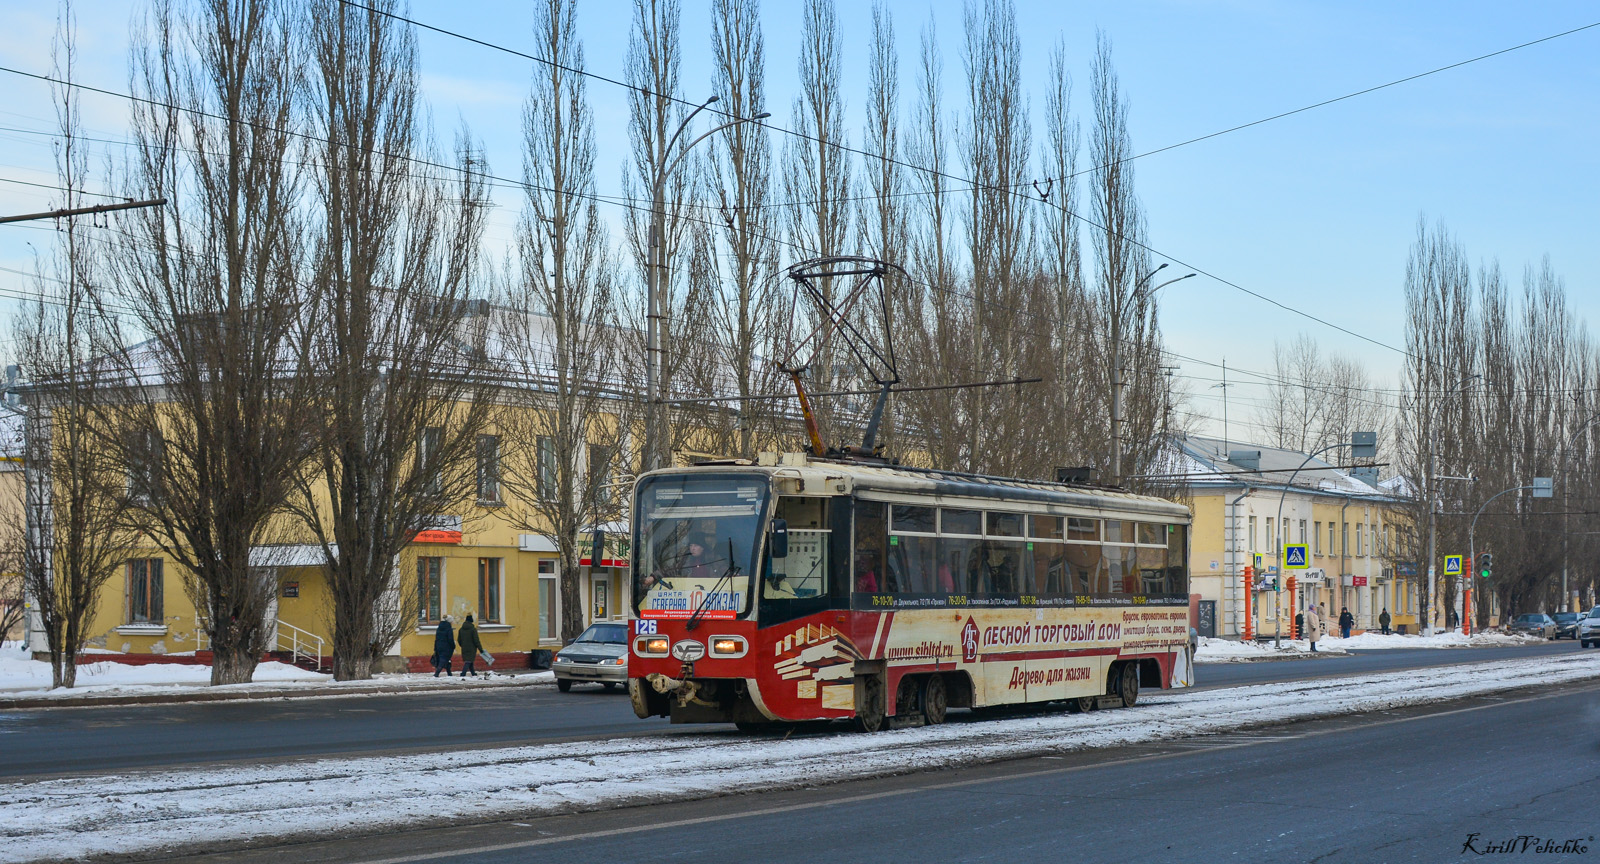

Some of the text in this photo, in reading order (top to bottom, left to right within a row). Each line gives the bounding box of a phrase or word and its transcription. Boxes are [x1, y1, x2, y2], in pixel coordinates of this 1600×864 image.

[652, 598, 687, 610] СЕВЕРНАЯ
[690, 591, 703, 610] 10
[635, 620, 658, 635] 126
[984, 619, 1121, 647] ЛЕСНОЙ ТОРГОВЫЙ ДОМ
[1009, 666, 1091, 689] Дерево для жизни
